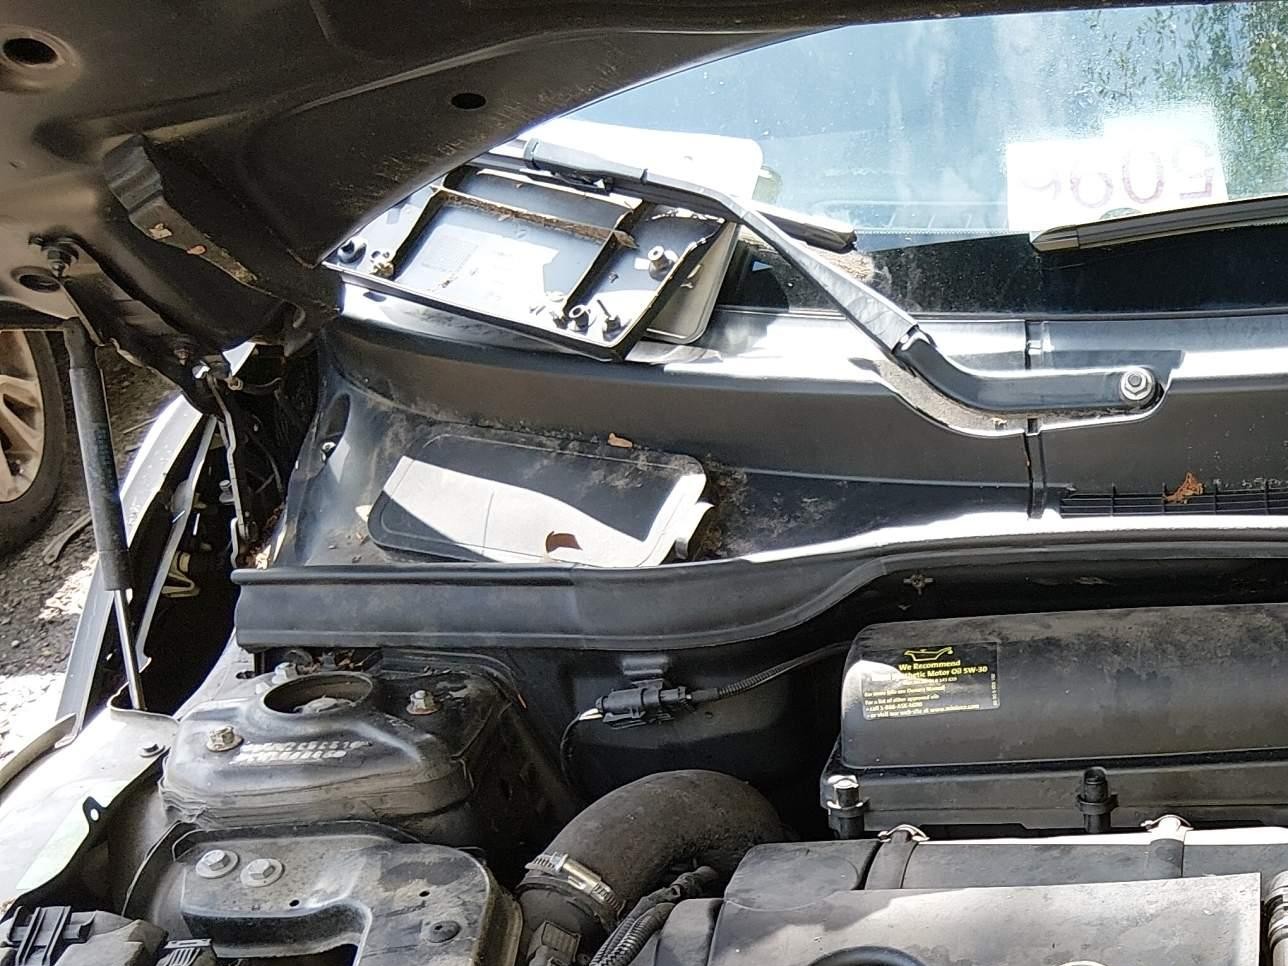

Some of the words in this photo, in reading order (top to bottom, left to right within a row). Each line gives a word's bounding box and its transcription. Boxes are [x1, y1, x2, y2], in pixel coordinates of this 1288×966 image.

[898, 664, 912, 672] We
[913, 659, 961, 670] Recommend
[927, 669, 950, 678] Motor
[951, 667, 962, 675] Oil
[963, 665, 988, 674] 5W-30
